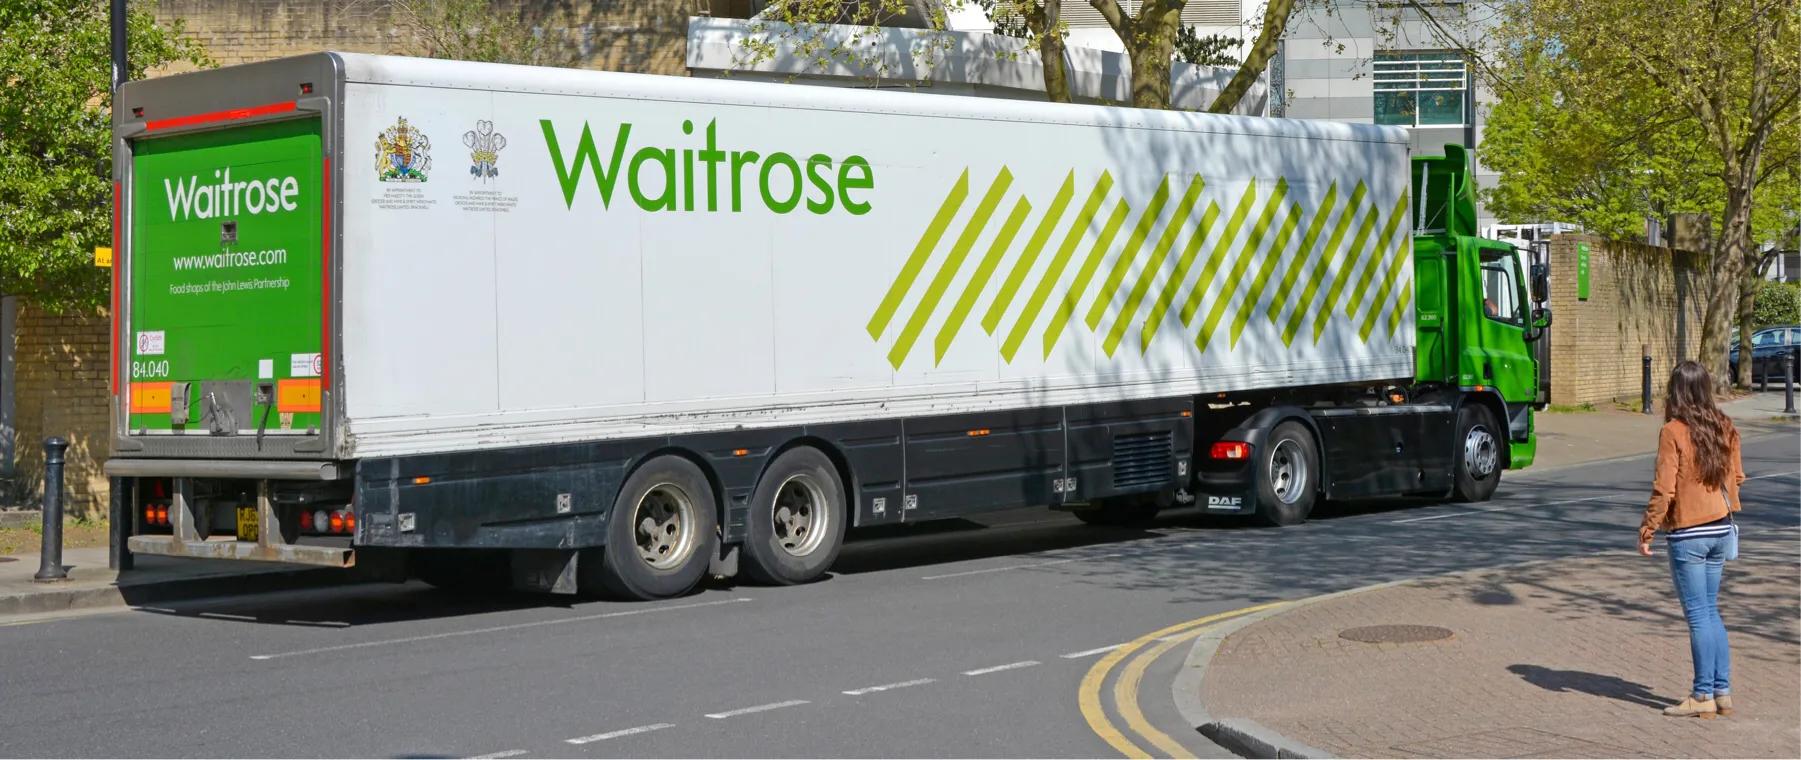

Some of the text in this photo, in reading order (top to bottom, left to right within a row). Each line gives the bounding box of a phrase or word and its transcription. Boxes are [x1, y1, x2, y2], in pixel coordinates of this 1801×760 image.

[539, 116, 875, 215] Waitrose
[164, 166, 299, 222] Waitrose
[173, 248, 287, 271] www.waitrose.com
[169, 276, 290, 296] Food shops of the John Lewis Partnership
[132, 360, 169, 378] 84.040
[1208, 496, 1241, 506] DAF
[240, 508, 259, 522] RJ6
